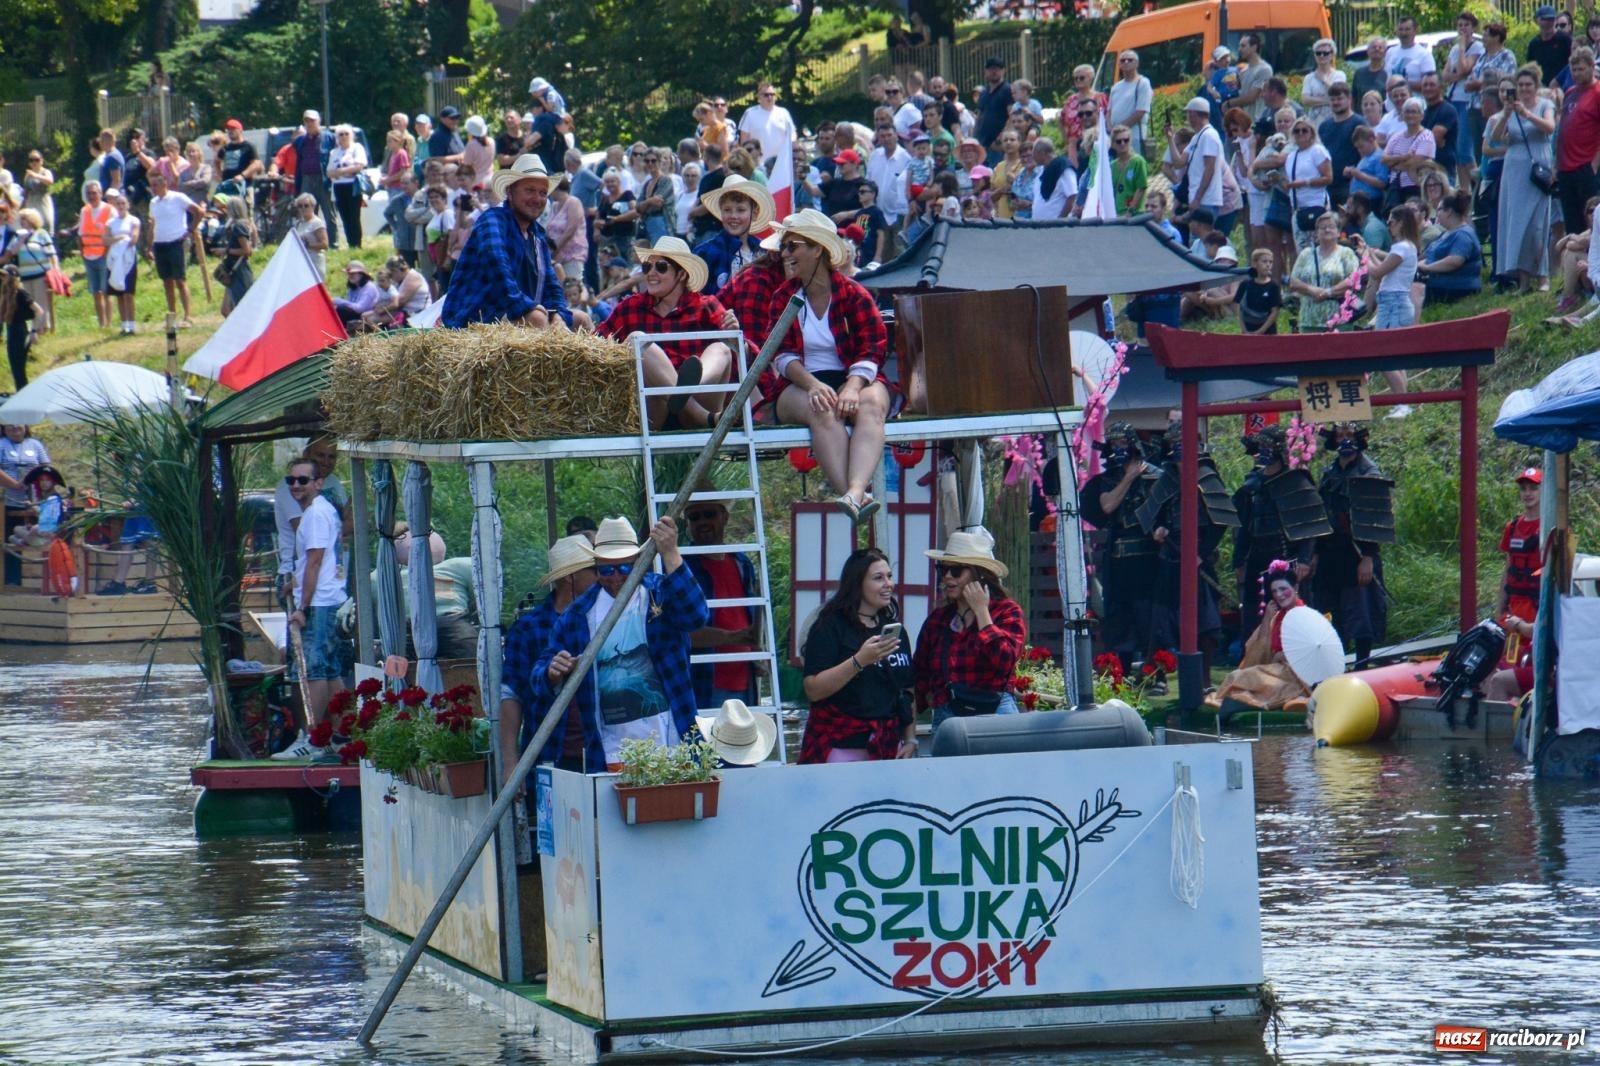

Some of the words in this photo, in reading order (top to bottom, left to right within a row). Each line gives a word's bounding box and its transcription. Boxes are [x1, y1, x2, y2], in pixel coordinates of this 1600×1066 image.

[811, 827, 1070, 889] ROLNIK
[832, 889, 1057, 943] SZUKA
[893, 936, 1051, 988] ŻONY
